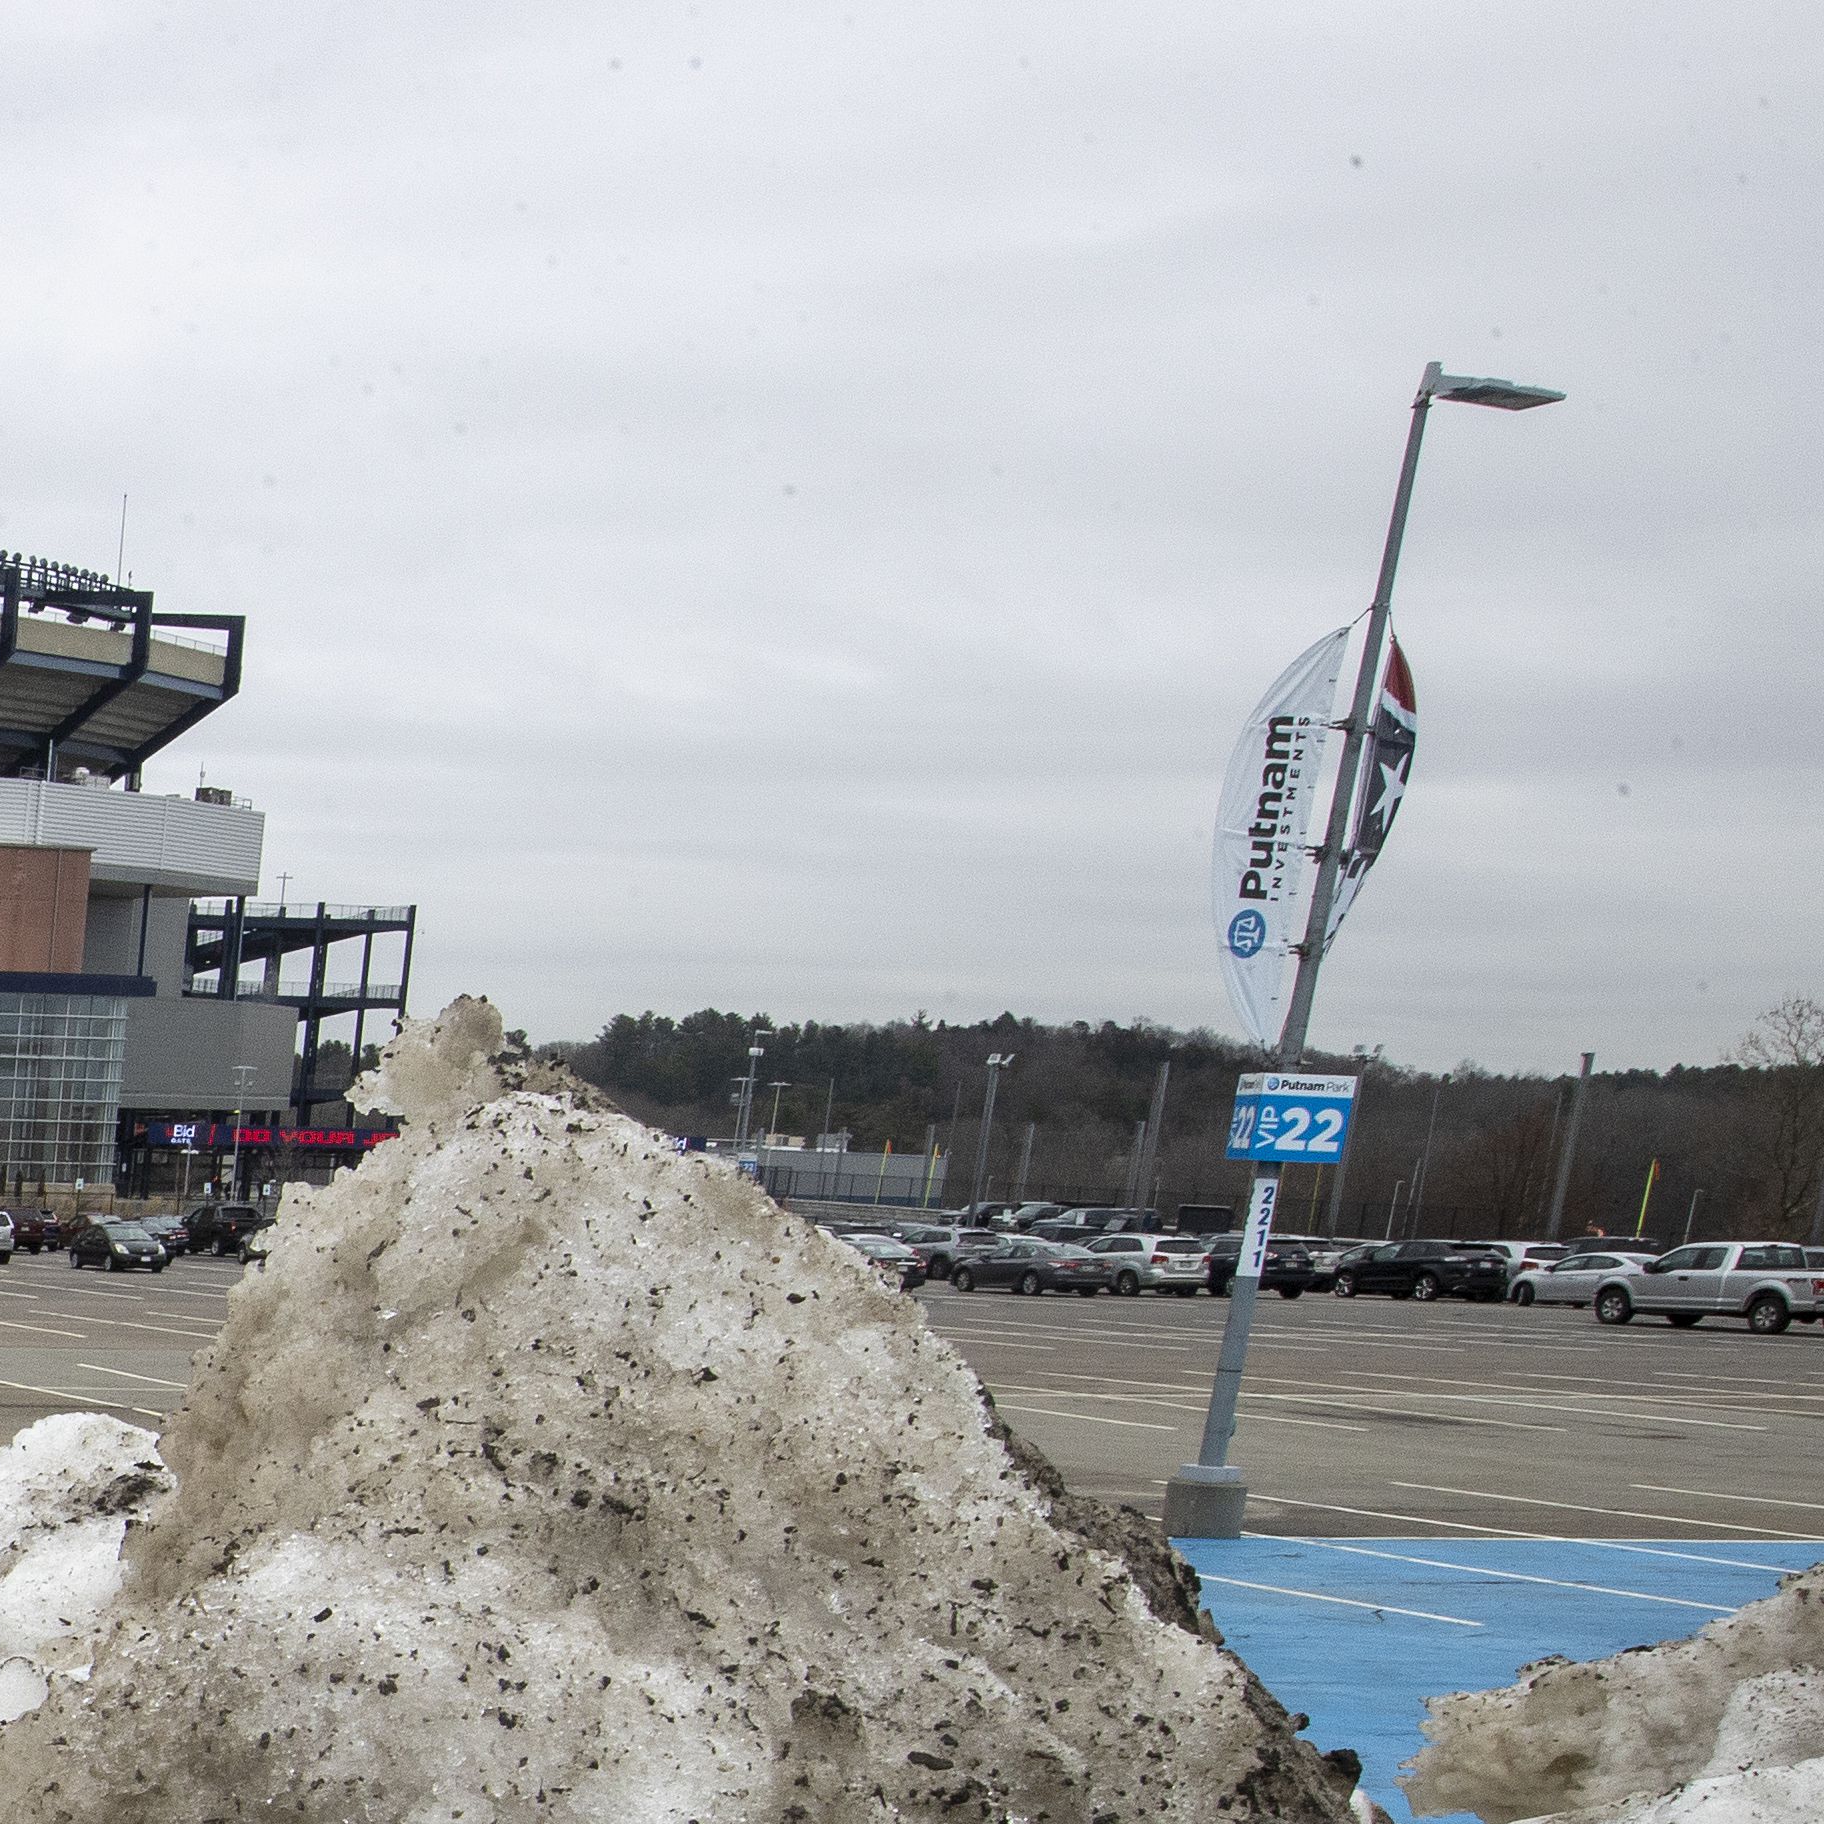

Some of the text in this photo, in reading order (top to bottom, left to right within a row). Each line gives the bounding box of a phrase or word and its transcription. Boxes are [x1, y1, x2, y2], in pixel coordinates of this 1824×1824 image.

[1239, 716, 1294, 900] Putnam
[1270, 716, 1311, 901] INVESTMENTS
[1281, 1079, 1350, 1092] Putnam Park
[233, 1129, 271, 1142] DO
[280, 1130, 354, 1144] YOUR
[1255, 1105, 1280, 1149] VIP
[1275, 1107, 1344, 1152] 22
[1253, 1186, 1275, 1268] 2211
